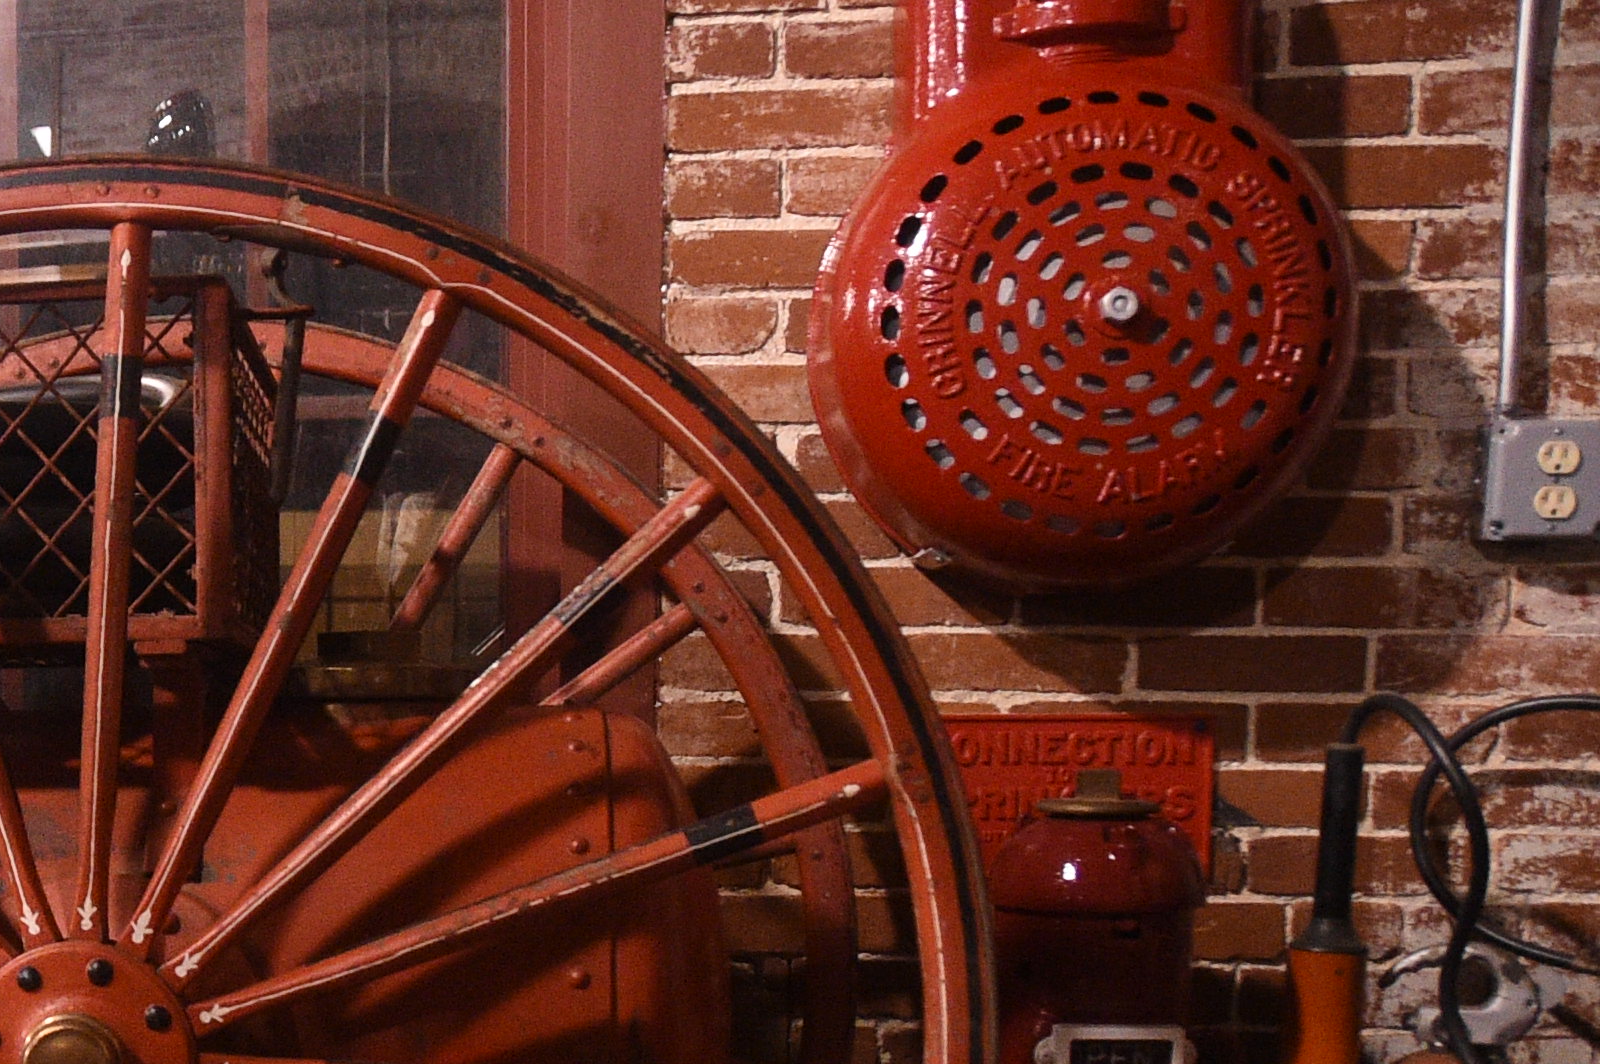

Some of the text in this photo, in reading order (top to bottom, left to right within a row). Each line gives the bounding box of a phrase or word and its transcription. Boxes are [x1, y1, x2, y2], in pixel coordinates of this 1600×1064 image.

[996, 120, 1312, 388] AUTOMATIC SPRINKLER
[986, 433, 1084, 499] FIRE
[951, 729, 1198, 767] ONNECTION
